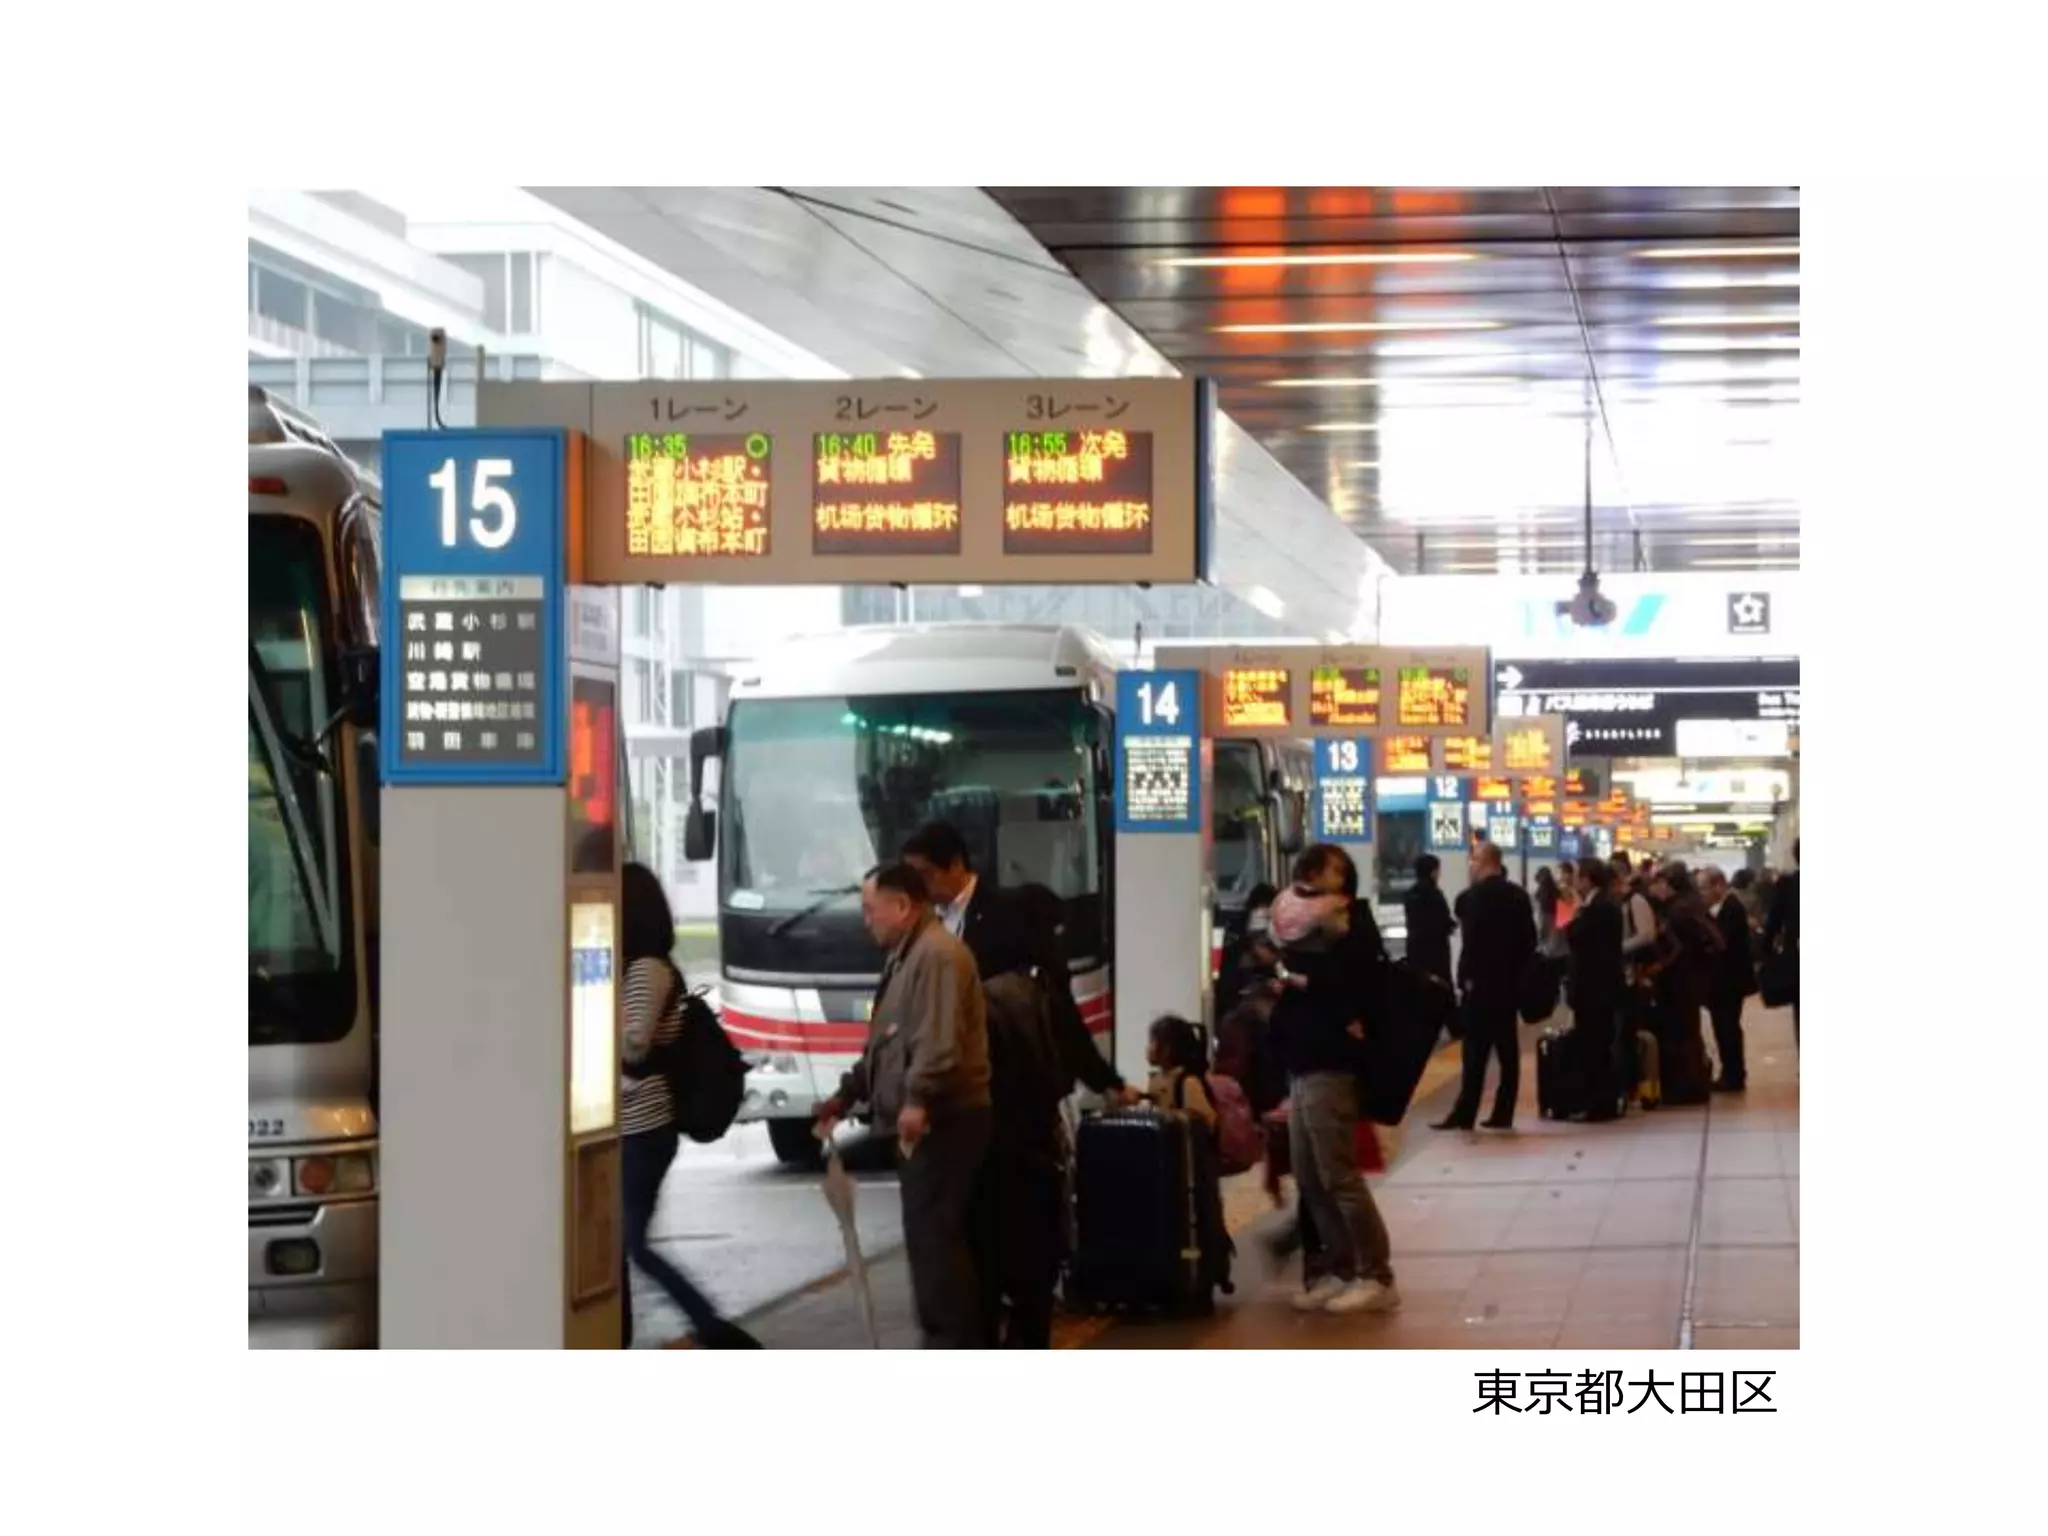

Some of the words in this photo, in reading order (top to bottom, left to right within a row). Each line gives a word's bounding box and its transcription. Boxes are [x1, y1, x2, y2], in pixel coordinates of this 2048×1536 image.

[651, 397, 748, 420] 1レーン
[835, 396, 938, 421] 2レーン
[1026, 394, 1130, 420] 3レーン
[429, 458, 517, 549] 15
[1136, 680, 1180, 726] 14
[1328, 740, 1358, 772] 13
[1434, 775, 1459, 798] 12
